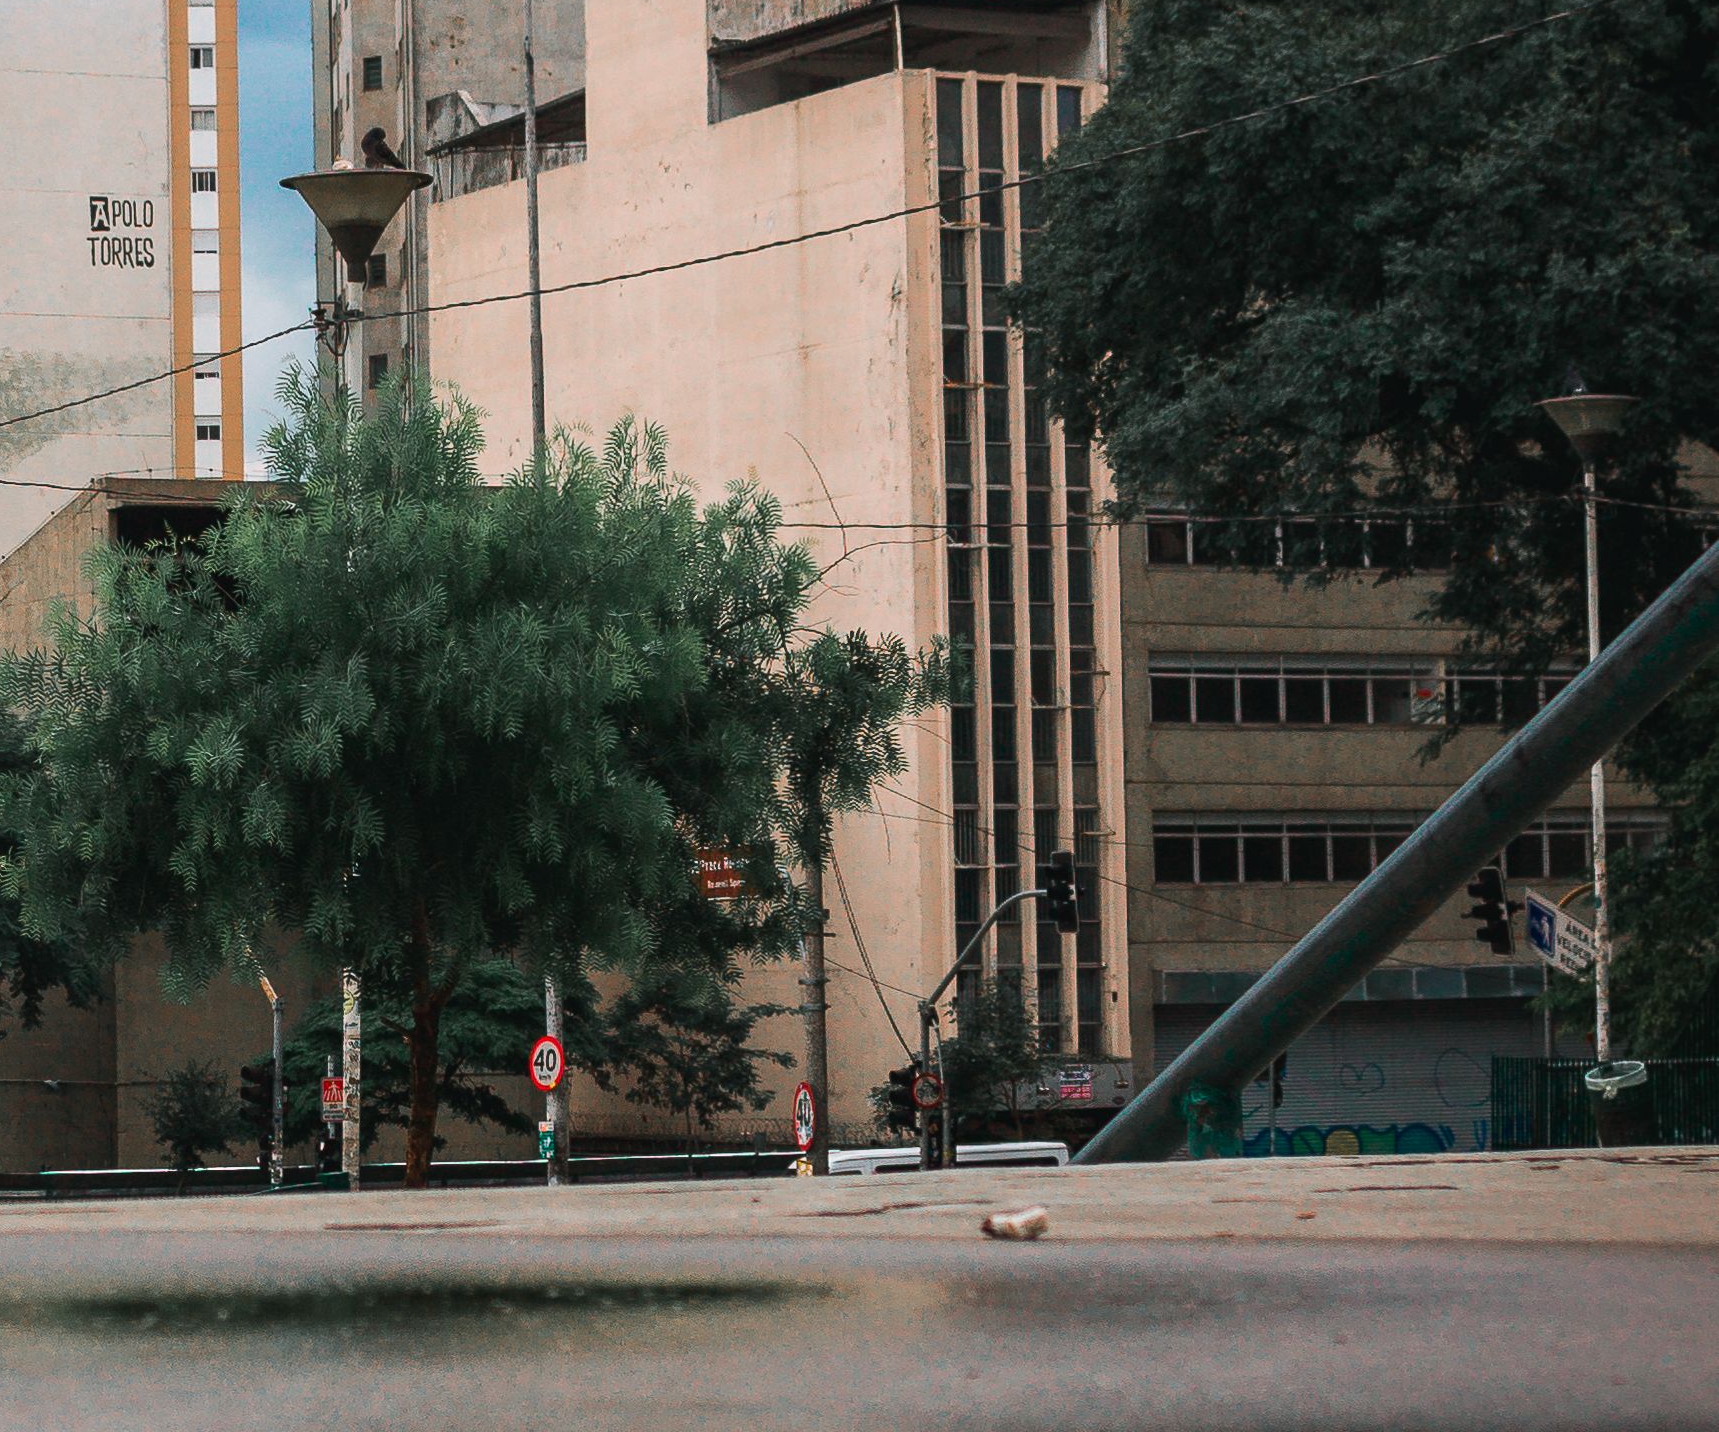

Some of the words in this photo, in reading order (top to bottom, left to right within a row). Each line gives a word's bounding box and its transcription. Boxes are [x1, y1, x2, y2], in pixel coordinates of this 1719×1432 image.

[90, 196, 154, 232] APOLO
[86, 236, 155, 269] TORRES
[534, 1048, 557, 1072] 40
